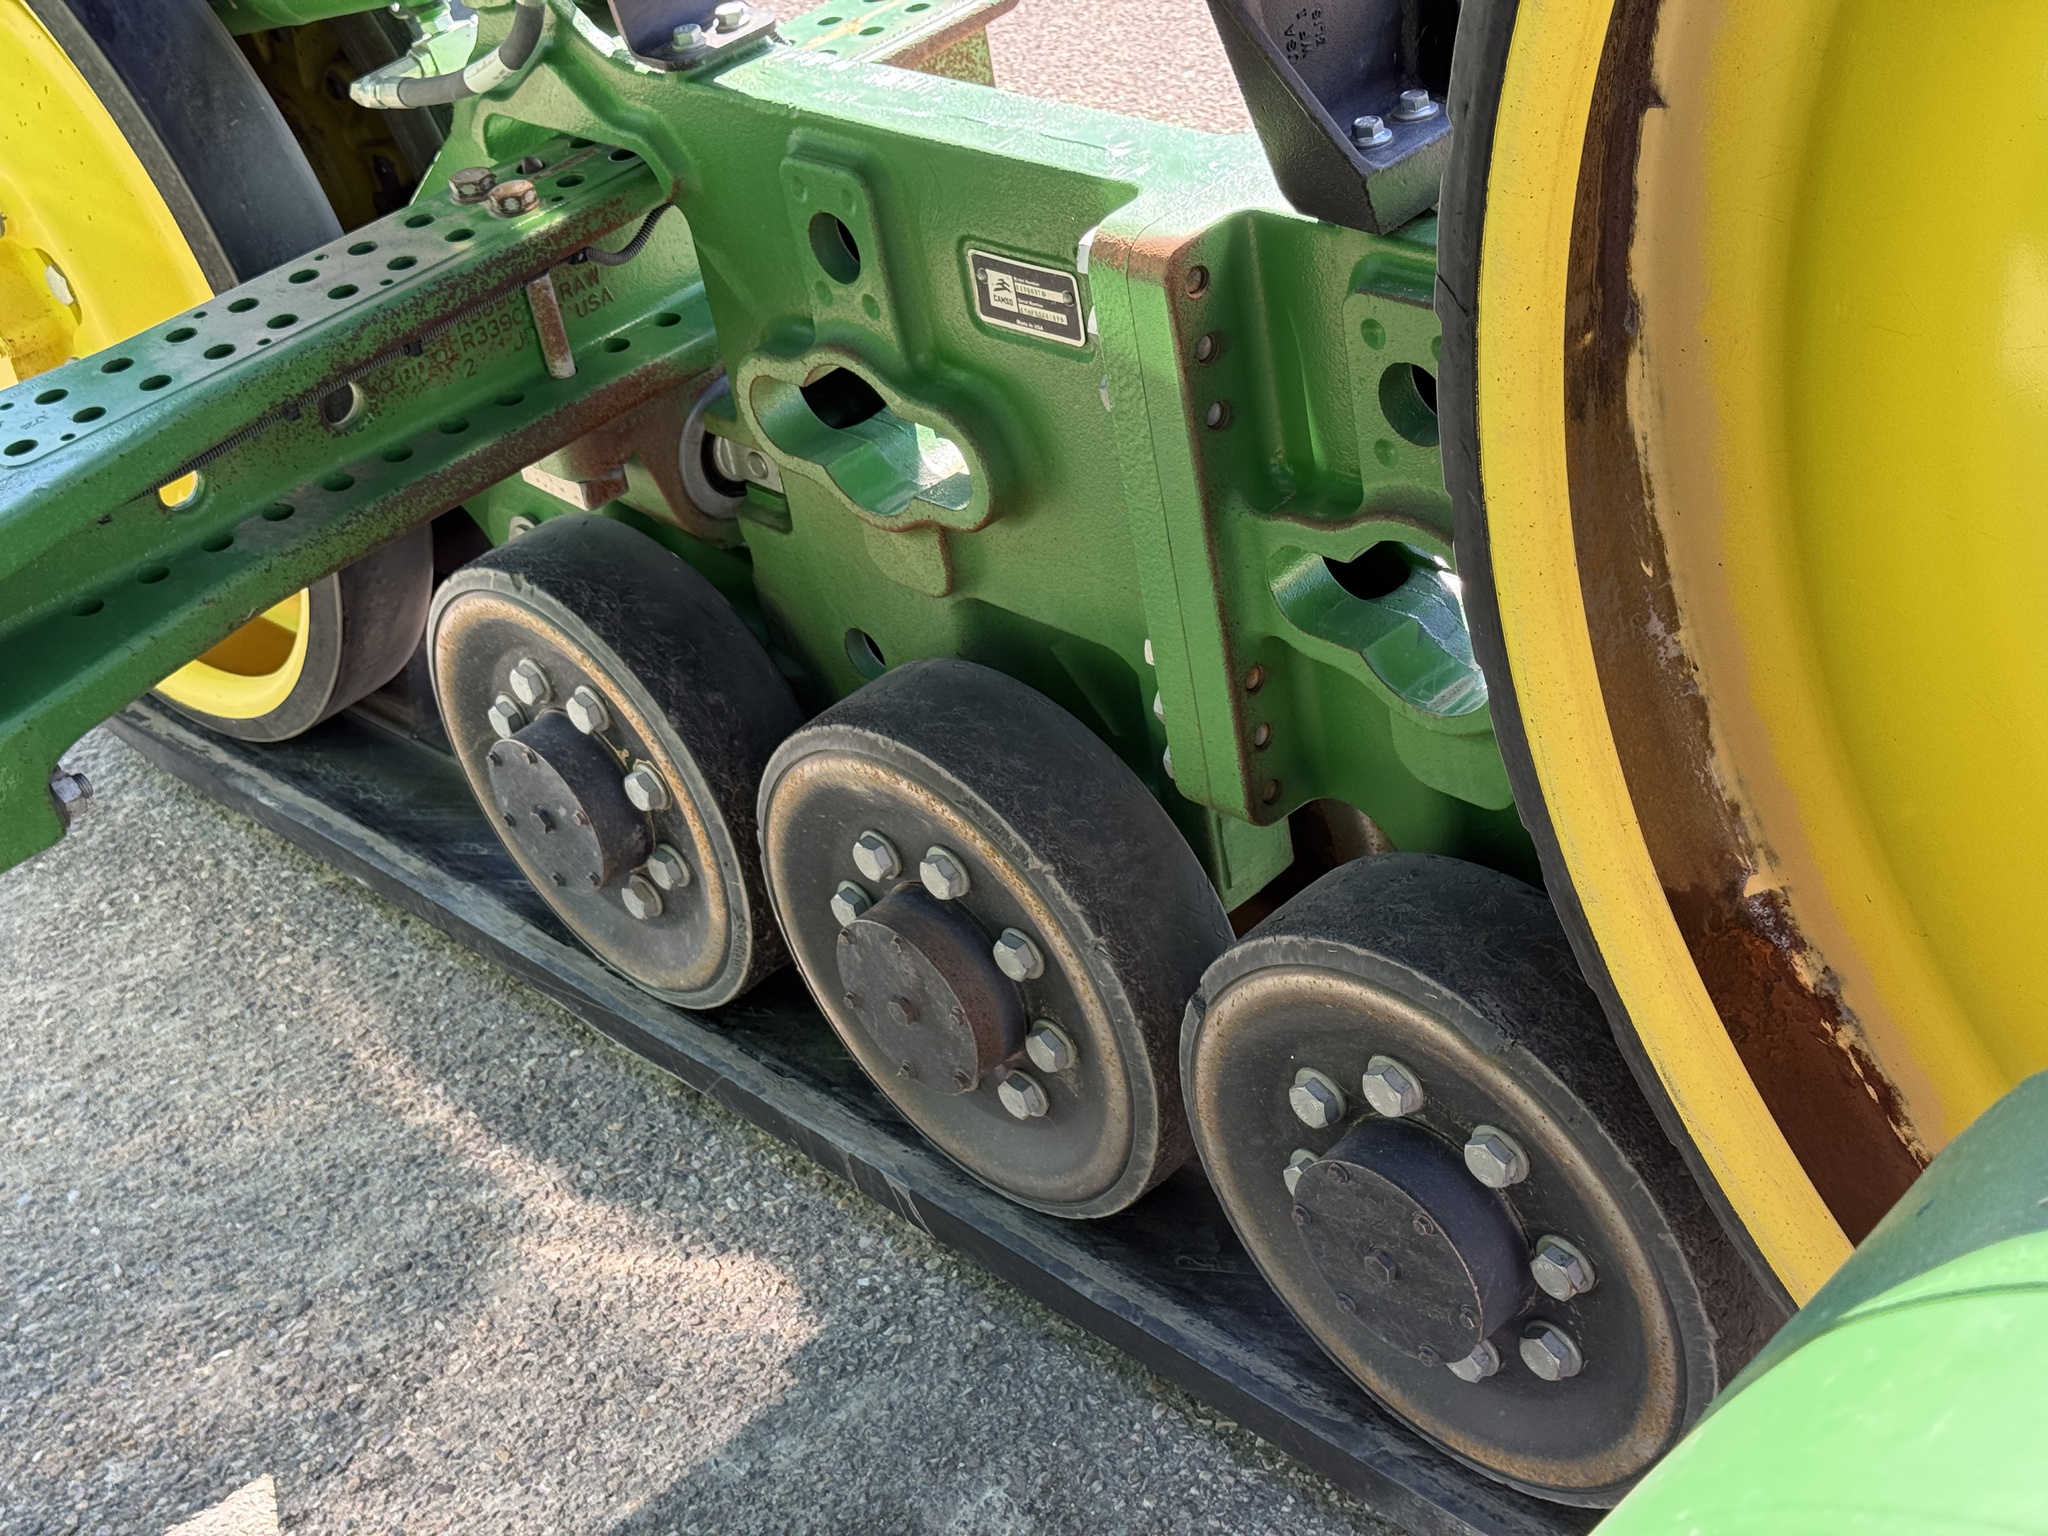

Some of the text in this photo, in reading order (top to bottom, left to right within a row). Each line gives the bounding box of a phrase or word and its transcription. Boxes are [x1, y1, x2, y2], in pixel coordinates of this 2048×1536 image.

[460, 307, 527, 352] R3390
[559, 265, 601, 302] RAW
[463, 358, 477, 379] 2
[576, 286, 616, 318] USA
[993, 293, 1013, 306] CAMSO
